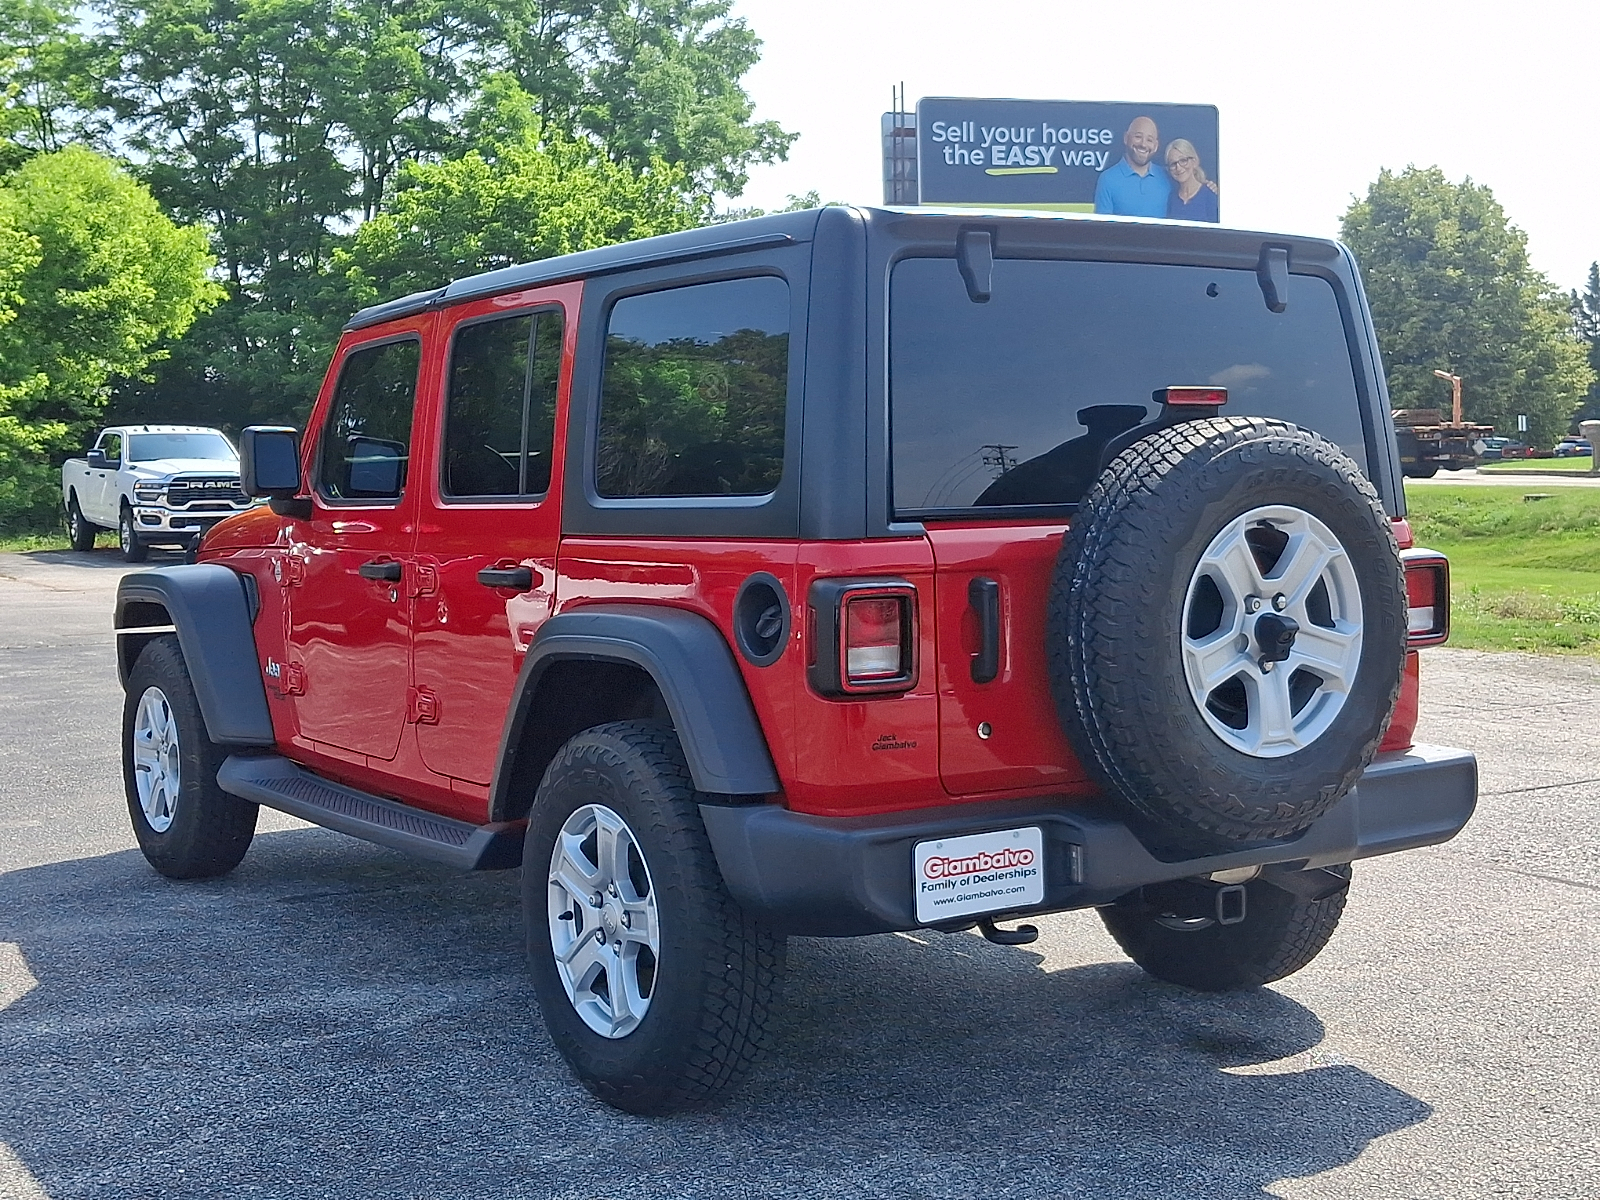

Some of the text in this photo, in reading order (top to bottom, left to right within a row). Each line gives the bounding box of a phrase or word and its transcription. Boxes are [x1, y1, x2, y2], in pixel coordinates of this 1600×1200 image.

[932, 121, 1113, 148] Sell your house
[943, 144, 1109, 172] the EASY way
[189, 481, 230, 489] RAM
[872, 741, 917, 751] Giambalvo
[877, 734, 897, 742] Jack
[923, 848, 1034, 880] Giambalvo
[921, 868, 1037, 893] Family of Dealerships
[933, 885, 1026, 906] www.Giambalvo.com
